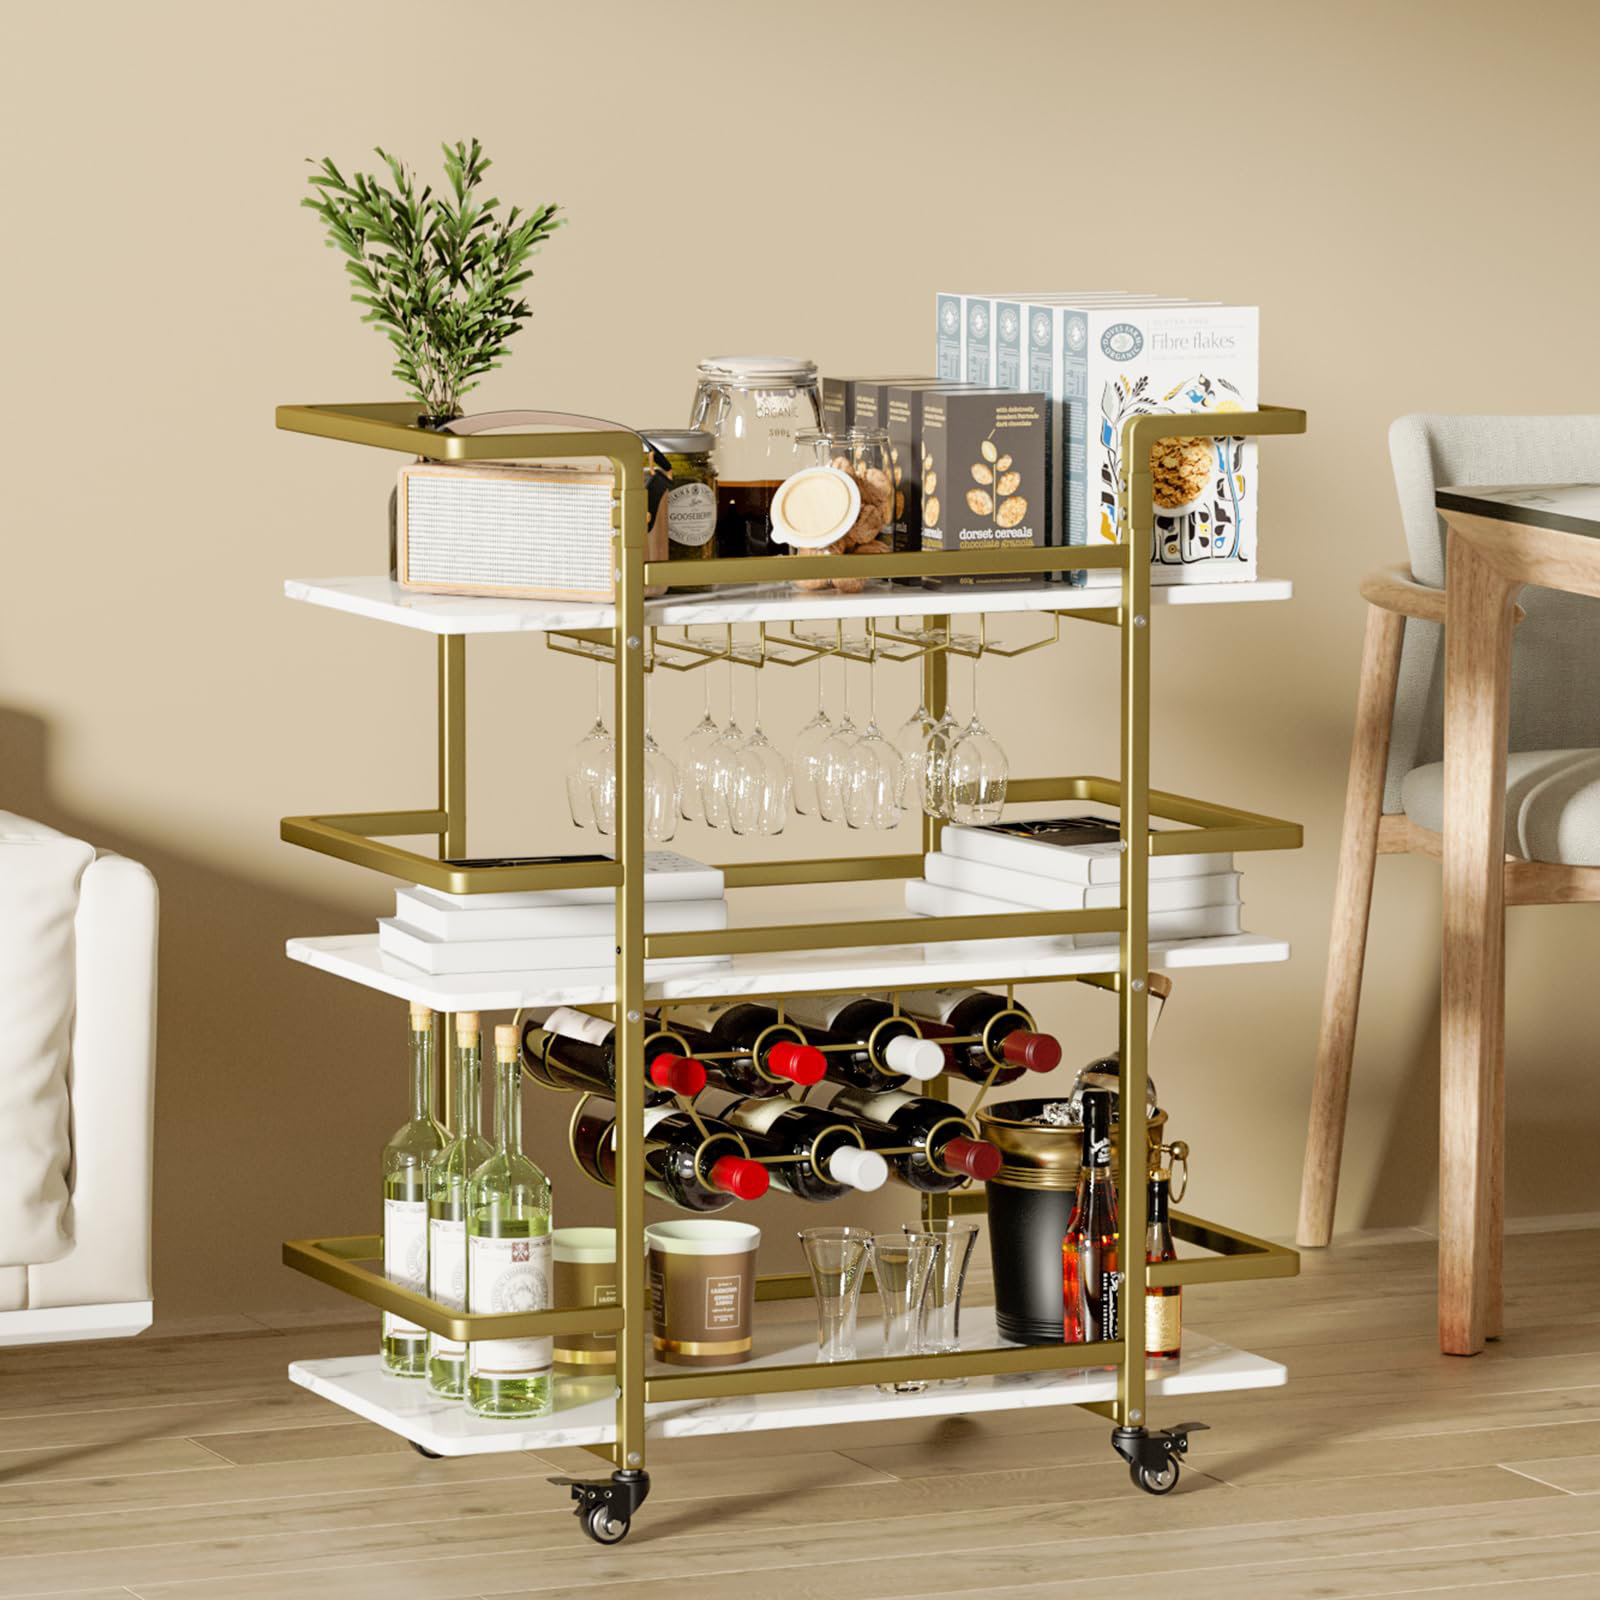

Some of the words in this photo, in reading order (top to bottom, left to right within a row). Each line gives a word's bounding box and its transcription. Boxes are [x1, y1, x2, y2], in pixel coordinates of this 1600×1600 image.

[1151, 332, 1189, 350] Fibre
[1193, 331, 1236, 350] flakes
[1104, 345, 1140, 360] ORGANIC
[959, 527, 994, 540] dorset
[994, 526, 1033, 539] cereals
